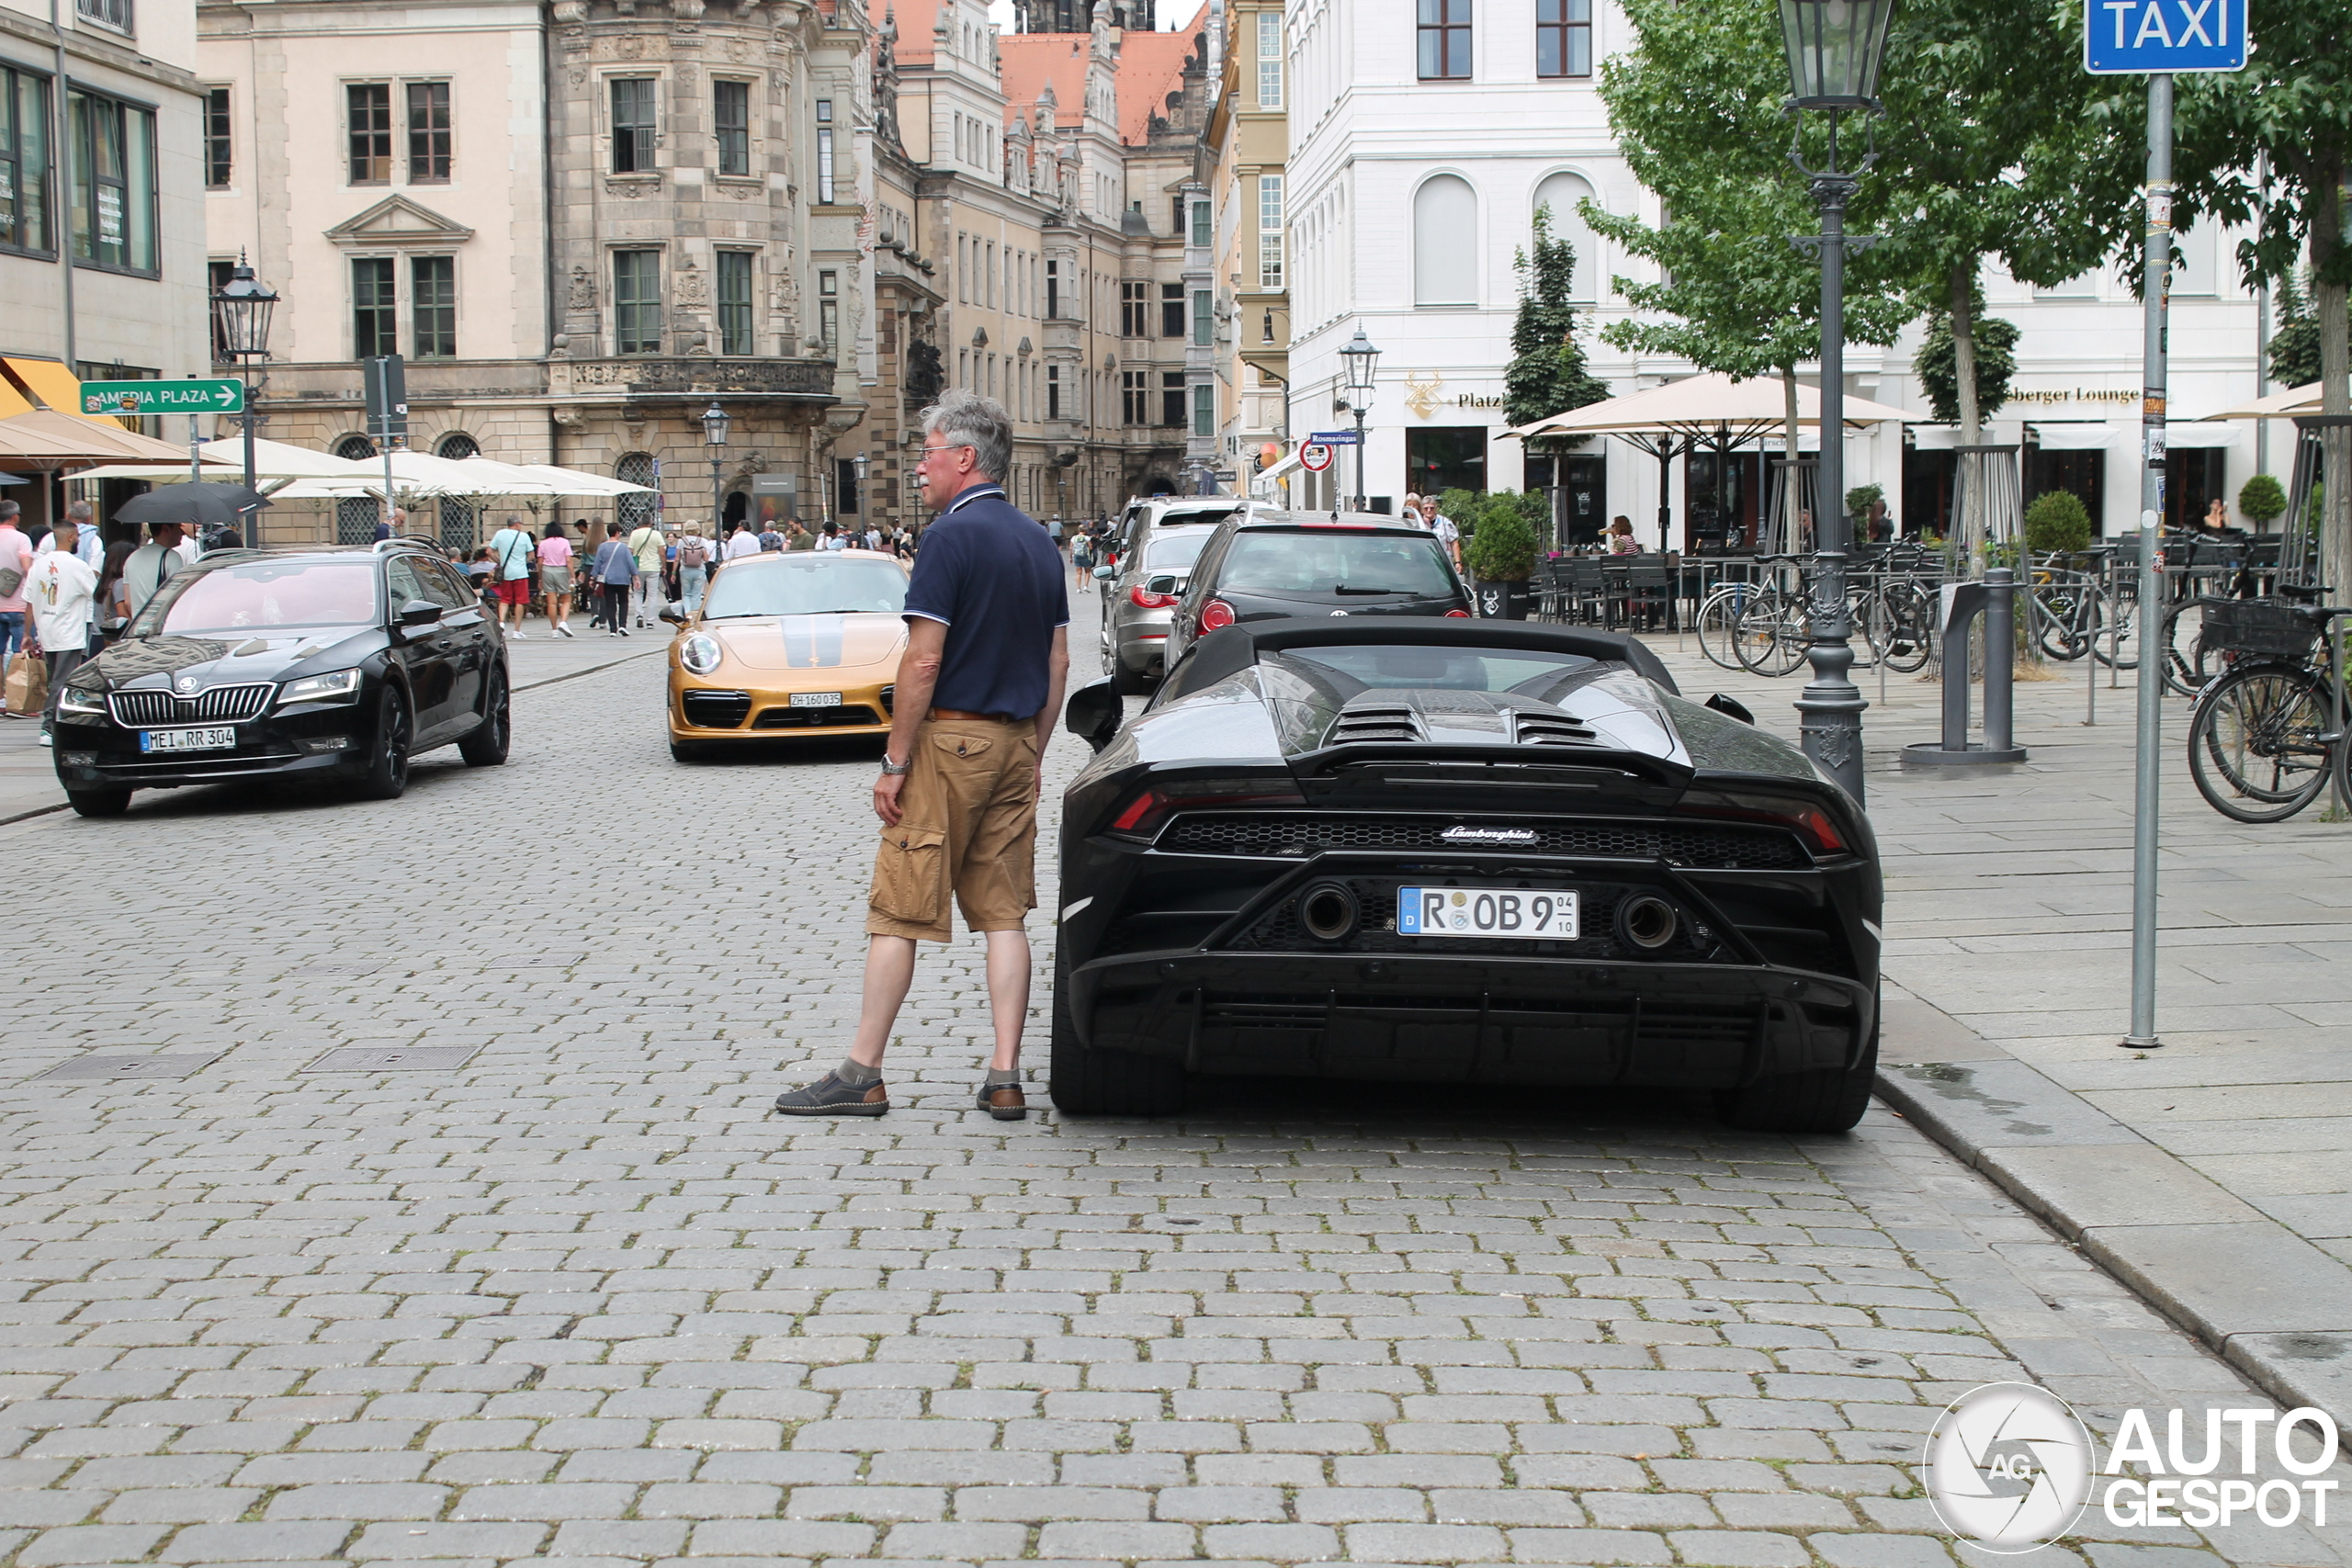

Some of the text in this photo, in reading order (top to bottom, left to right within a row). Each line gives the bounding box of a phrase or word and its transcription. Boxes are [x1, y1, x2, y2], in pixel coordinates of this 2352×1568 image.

[2103, 0, 2227, 50] TAXI
[161, 389, 210, 403] PLAZA
[2075, 387, 2140, 405] Lounge
[1312, 434, 1357, 443] Rosmaringas
[150, 728, 233, 749] MEI RR 304
[1442, 826, 1534, 841] Lamborghini
[1557, 897, 1572, 908] 04
[1423, 893, 1554, 931] R OB 9
[1405, 915, 1415, 926] D
[1558, 921, 1573, 932] 10
